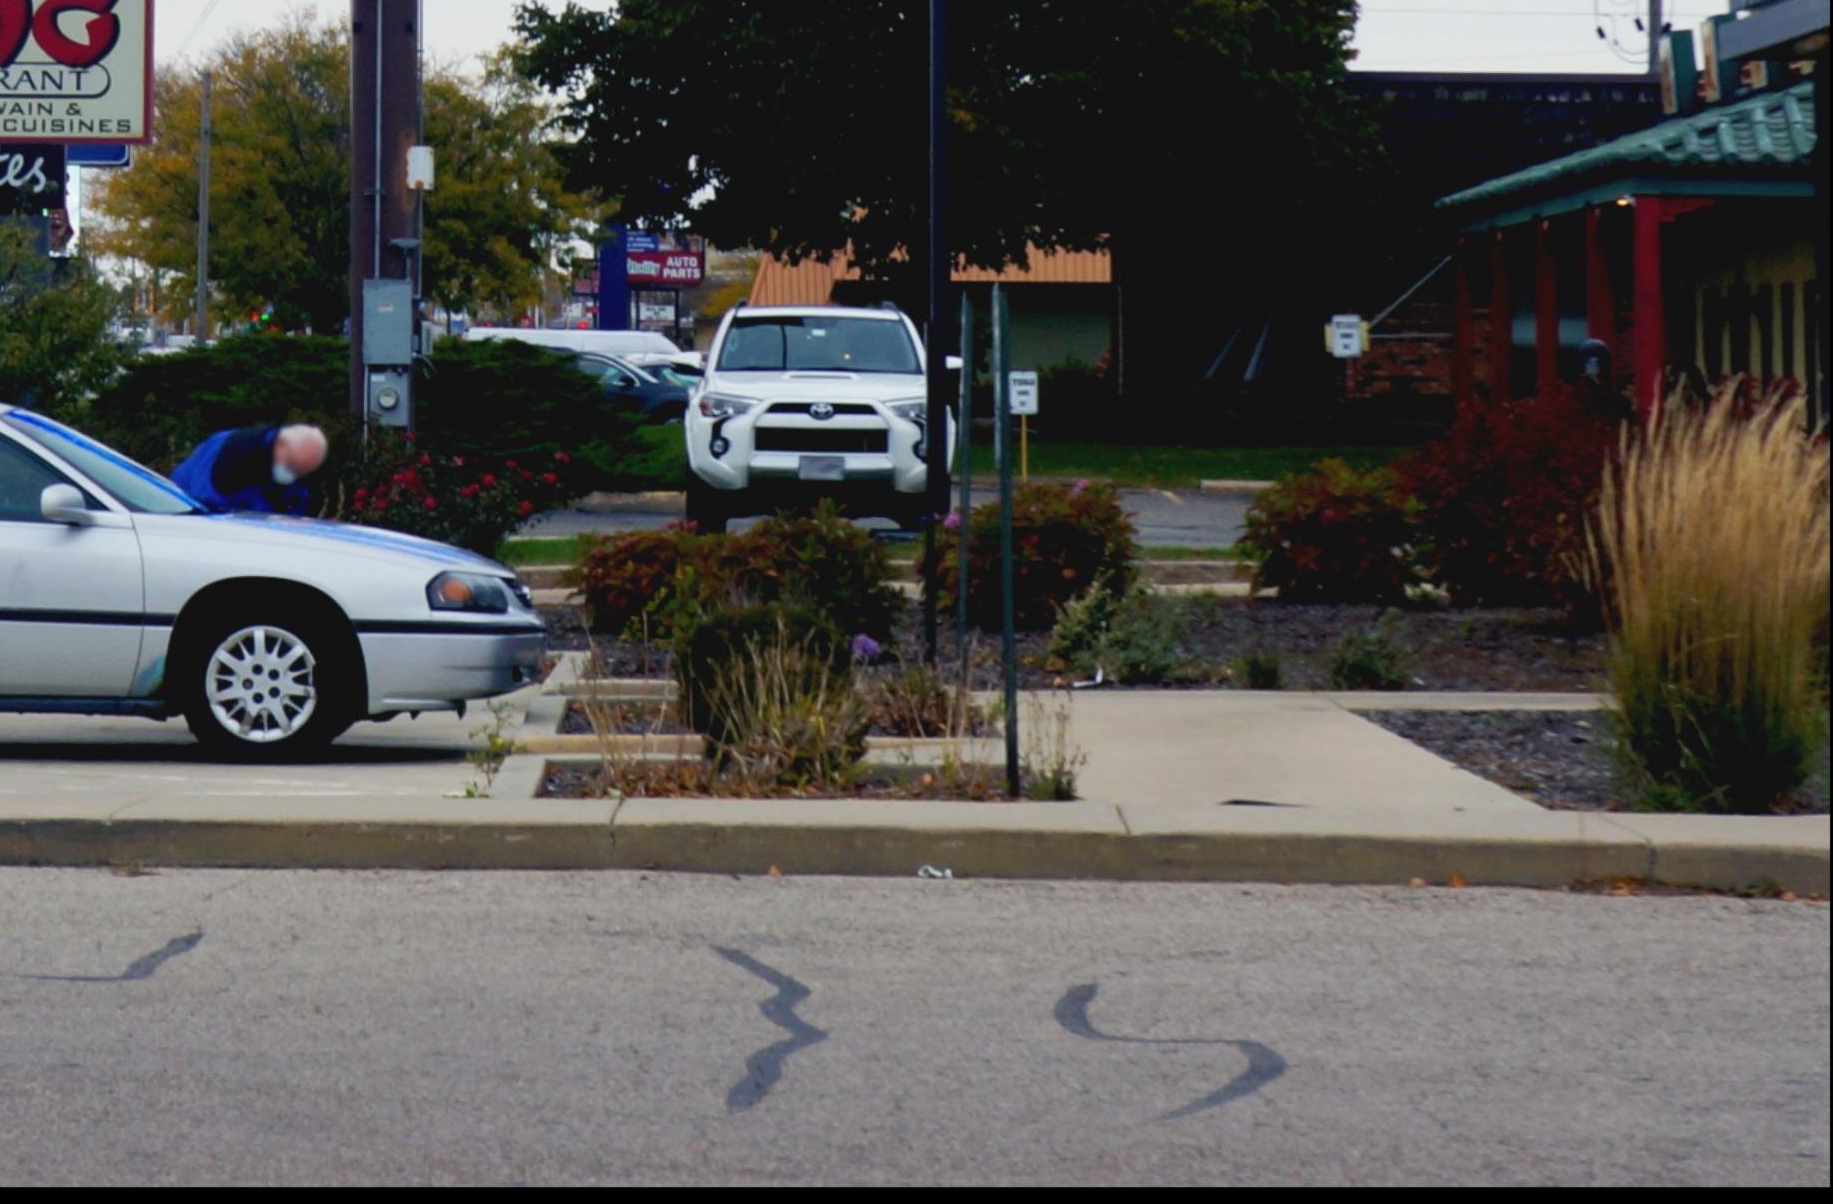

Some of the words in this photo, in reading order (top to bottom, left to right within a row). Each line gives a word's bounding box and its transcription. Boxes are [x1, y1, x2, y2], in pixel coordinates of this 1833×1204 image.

[65, 102, 83, 117] &
[2, 118, 132, 134] CUISINES
[666, 256, 698, 267] AUTO
[663, 268, 701, 279] PARTS
